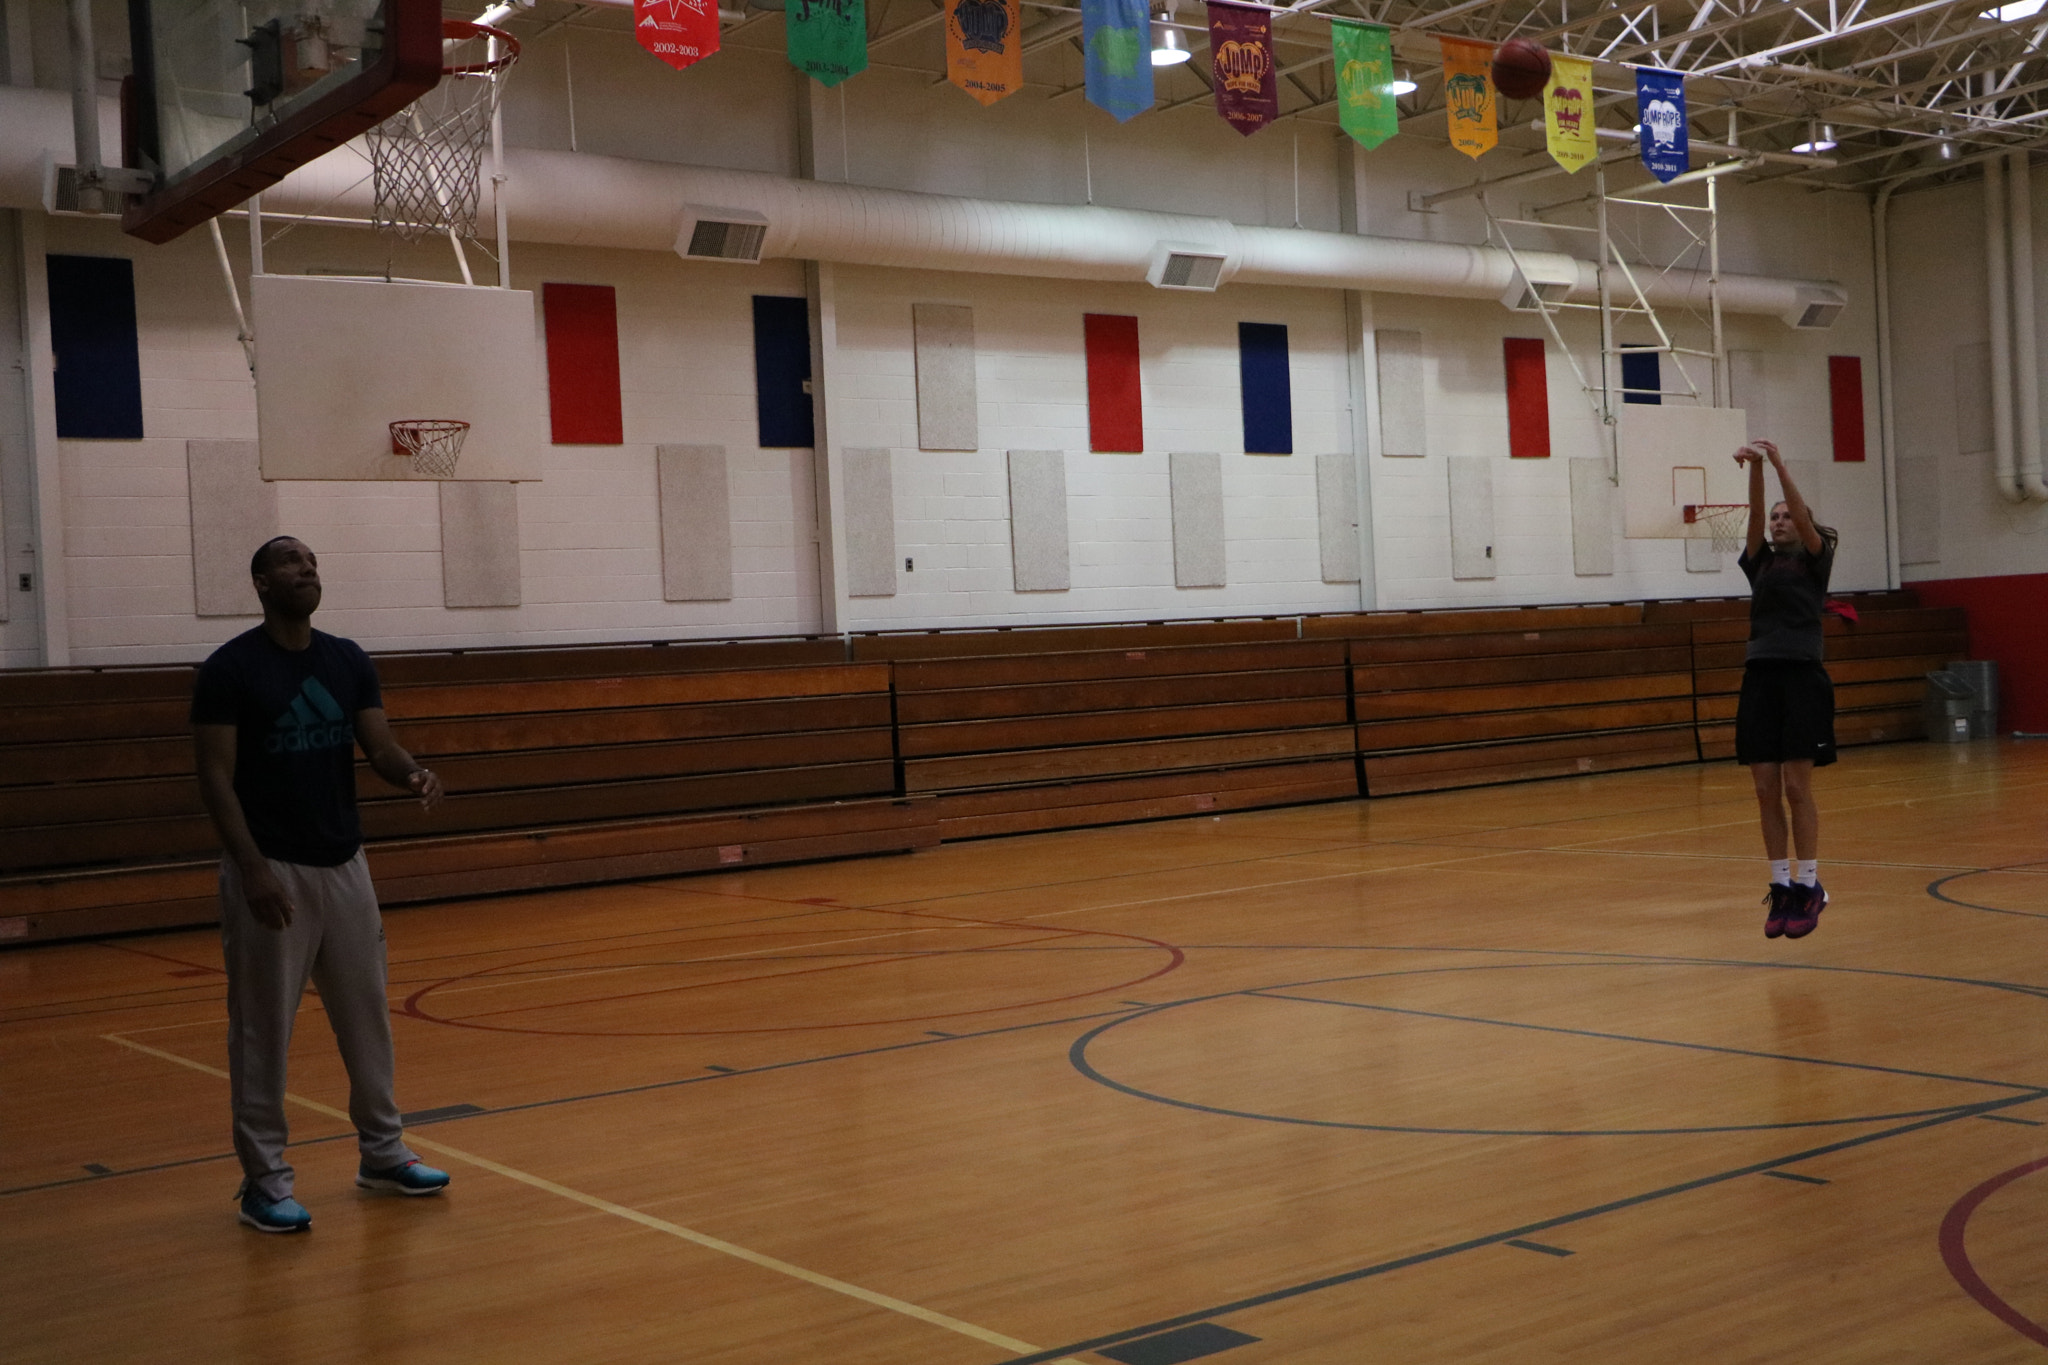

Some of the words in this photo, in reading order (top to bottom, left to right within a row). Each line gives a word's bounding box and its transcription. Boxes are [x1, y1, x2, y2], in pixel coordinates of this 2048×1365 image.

[1223, 46, 1261, 80] JUMP
[965, 79, 1006, 92] 2004-2005
[1227, 111, 1263, 122] 2006-2007
[1643, 107, 1662, 127] JUMP
[1661, 109, 1682, 128] ROPE
[264, 721, 353, 753] adidas
